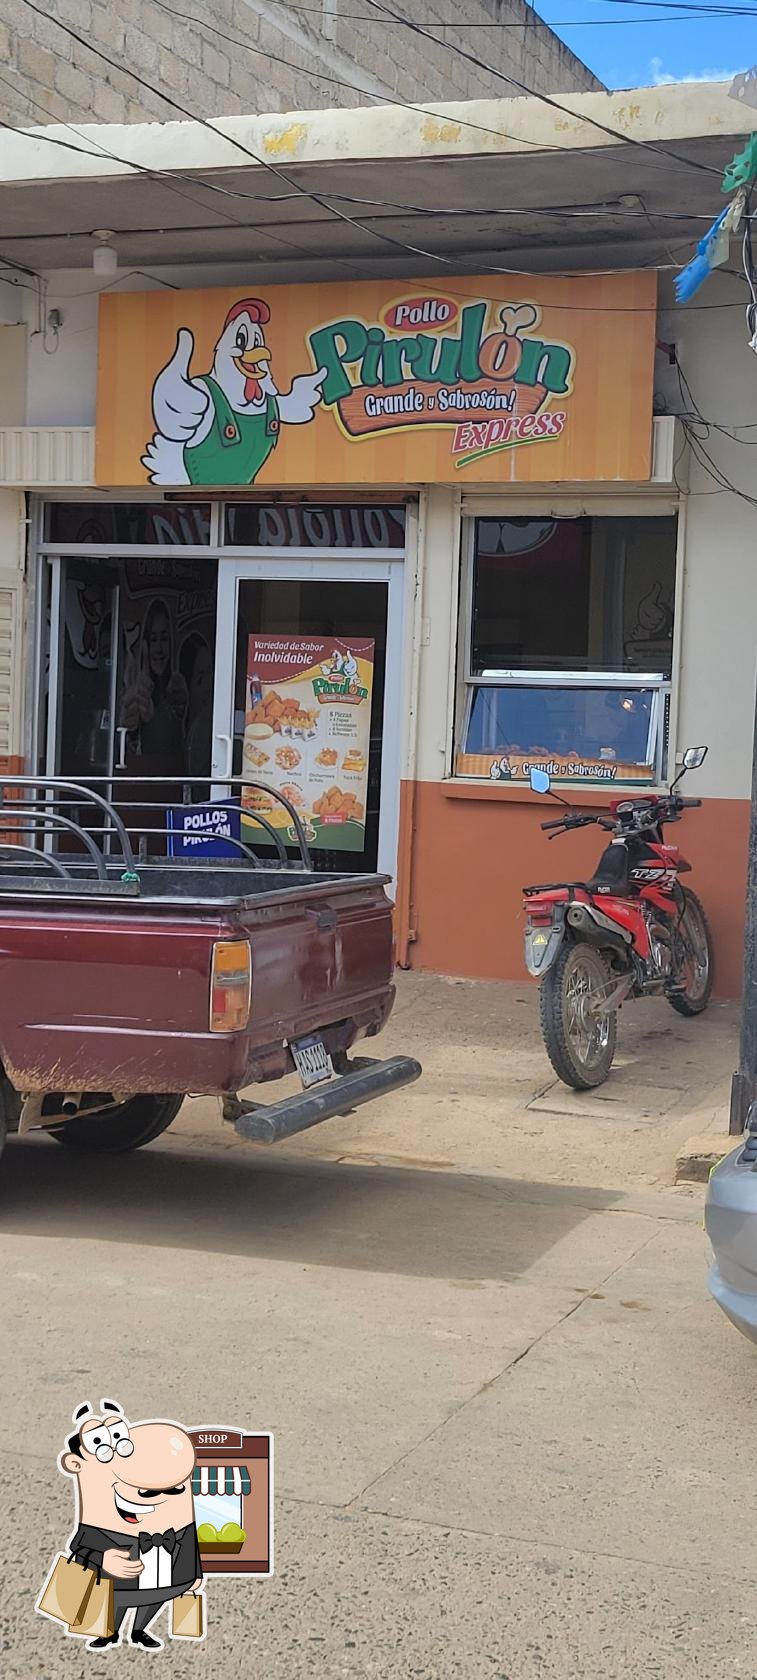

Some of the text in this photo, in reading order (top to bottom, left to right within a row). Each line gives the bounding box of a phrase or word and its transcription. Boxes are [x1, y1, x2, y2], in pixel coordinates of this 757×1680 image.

[395, 300, 450, 326] Pollo
[310, 303, 571, 405] Pirulón
[365, 388, 517, 417] Grande y Sabrosón!
[452, 411, 567, 453] Express
[254, 641, 325, 652] Variedad de Sabor
[254, 651, 313, 664] Inolvidable
[568, 762, 617, 779] Sabrosón!
[183, 811, 228, 831] POLLOS
